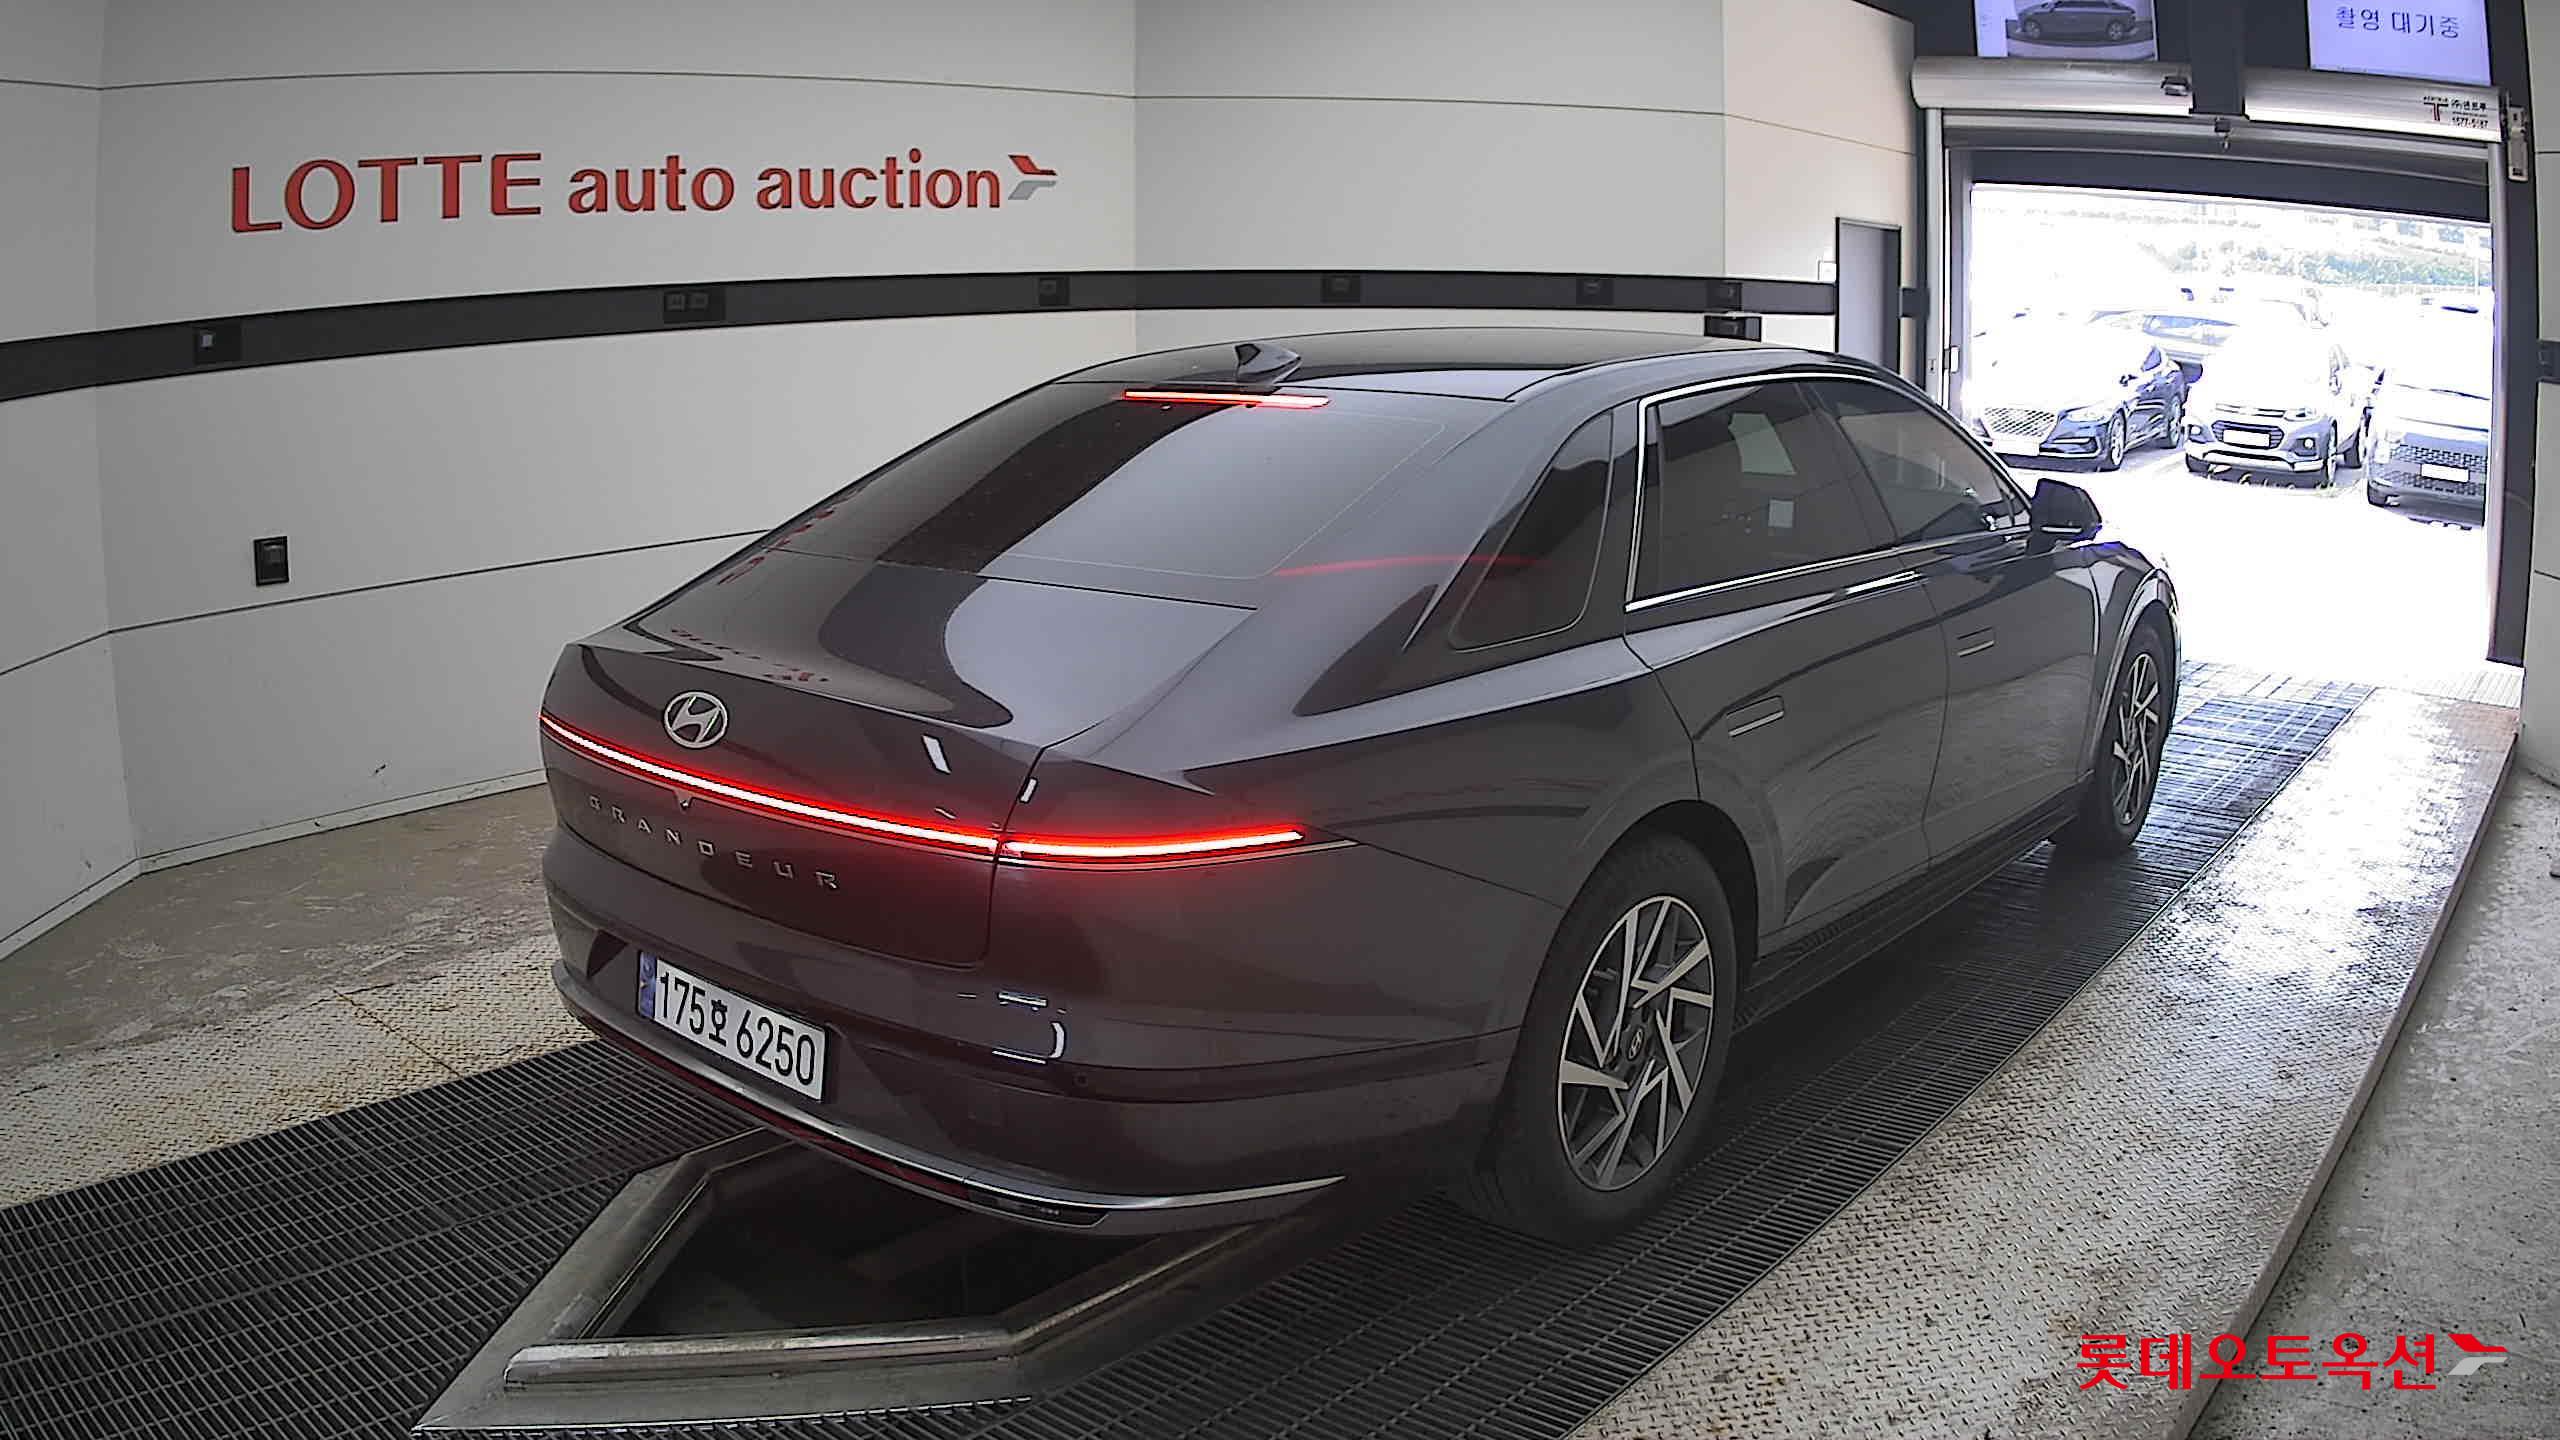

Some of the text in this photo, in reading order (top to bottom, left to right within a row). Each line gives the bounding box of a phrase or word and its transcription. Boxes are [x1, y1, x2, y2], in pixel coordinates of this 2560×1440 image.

[2336, 6, 2460, 39] 촬영 대기중
[231, 148, 1001, 233] LOTTE auto auction
[588, 795, 838, 889] GRANDEUR
[736, 1009, 816, 1086] 6250
